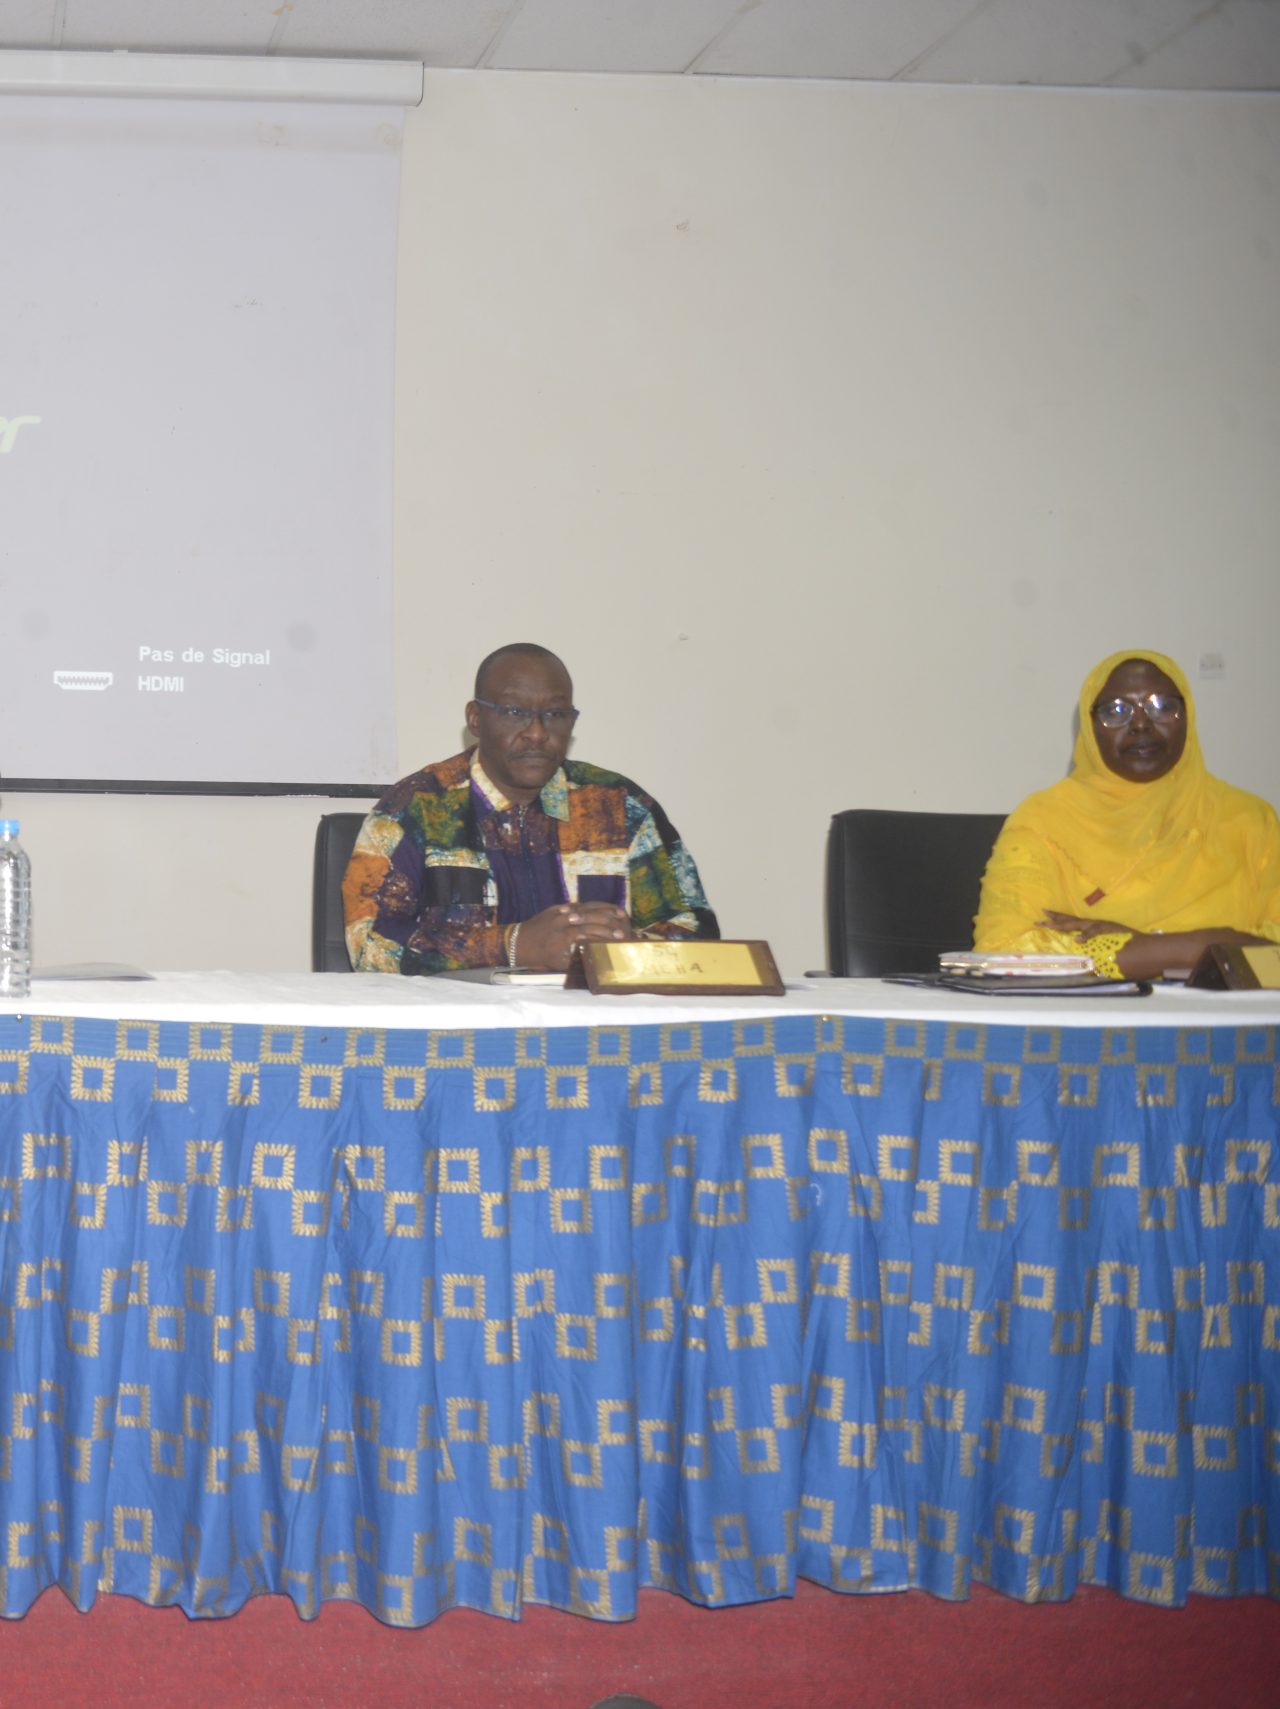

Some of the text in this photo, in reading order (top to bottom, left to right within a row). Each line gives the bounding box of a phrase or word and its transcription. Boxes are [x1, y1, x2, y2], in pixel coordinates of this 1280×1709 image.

[139, 646, 271, 668] Pas de Signal
[138, 675, 184, 692] HDMI
